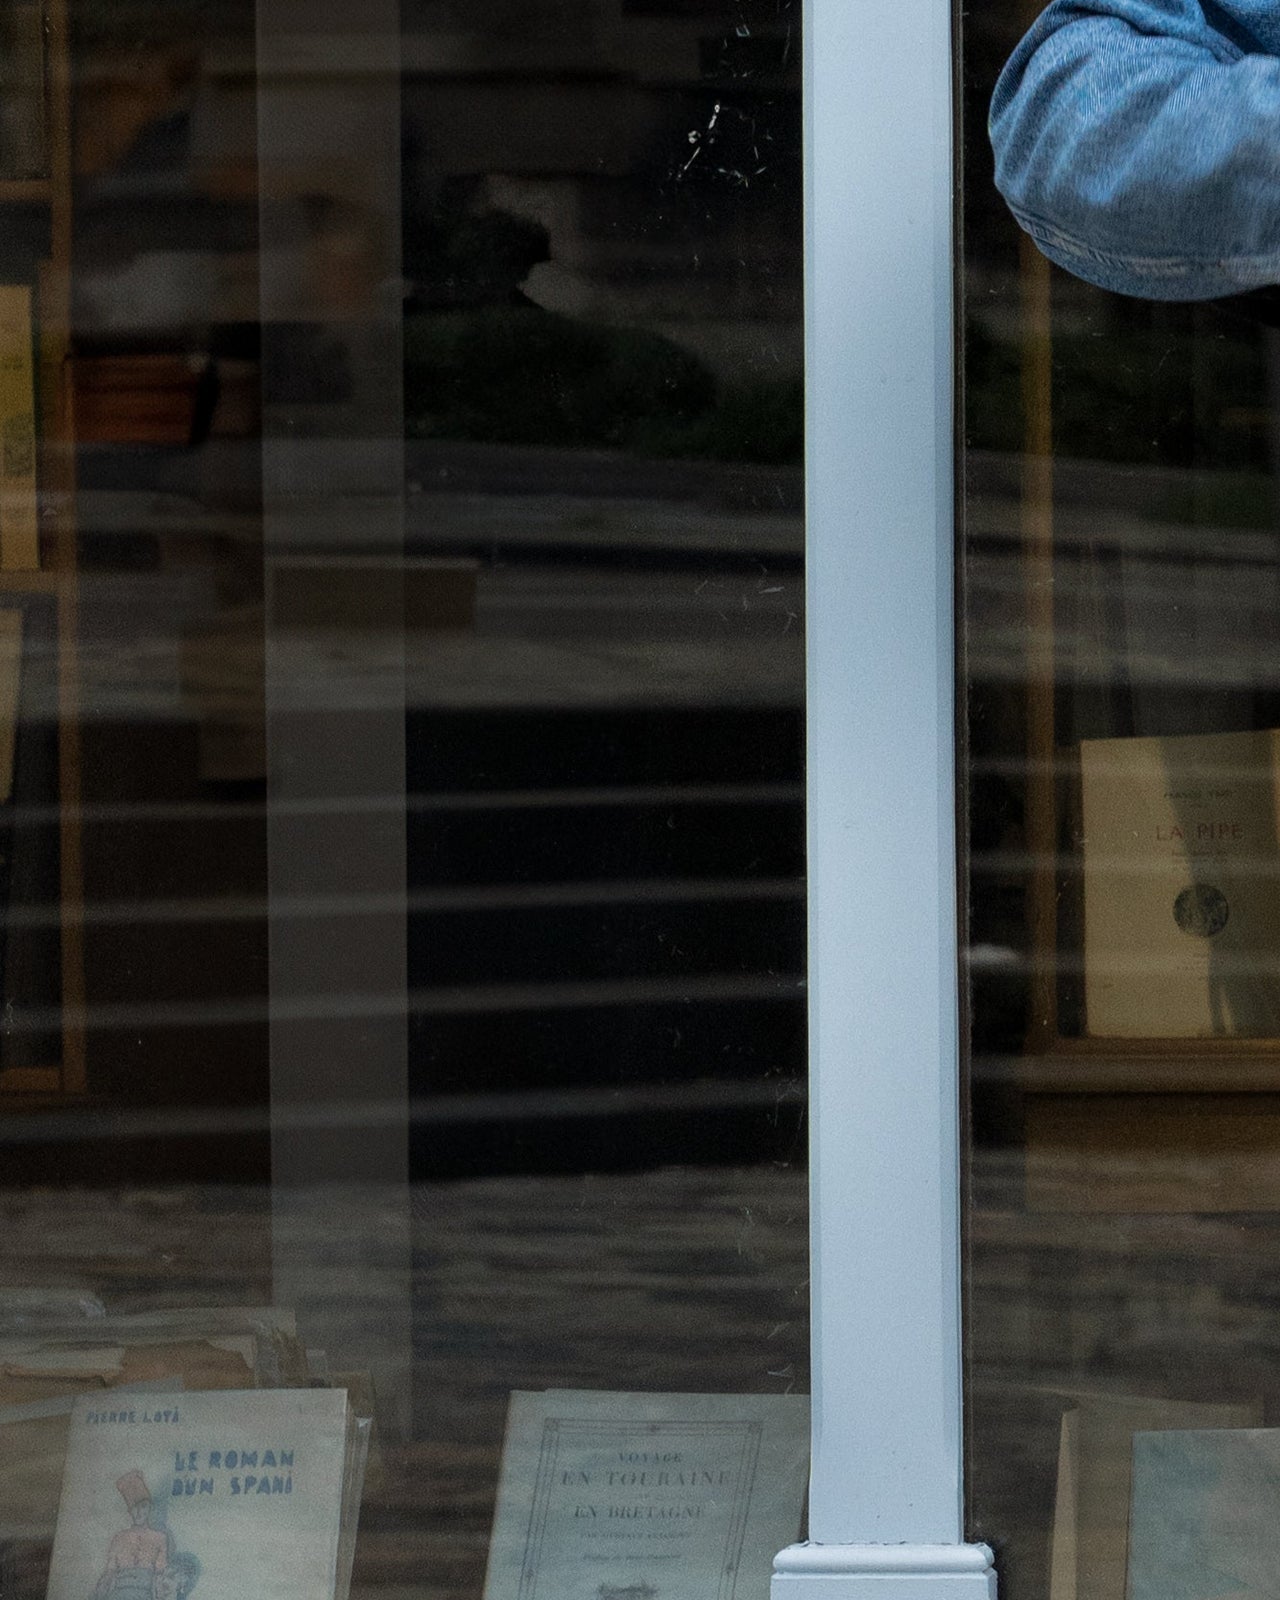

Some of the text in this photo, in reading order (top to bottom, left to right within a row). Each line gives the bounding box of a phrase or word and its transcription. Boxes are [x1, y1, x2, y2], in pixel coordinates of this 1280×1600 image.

[1155, 822, 1244, 841] LA PIPE
[174, 1449, 295, 1472] LE ROMAN
[619, 1452, 683, 1464] VOYAGE
[561, 1470, 731, 1487] EN TOURAINE
[607, 1505, 706, 1520] BRETAGNE
